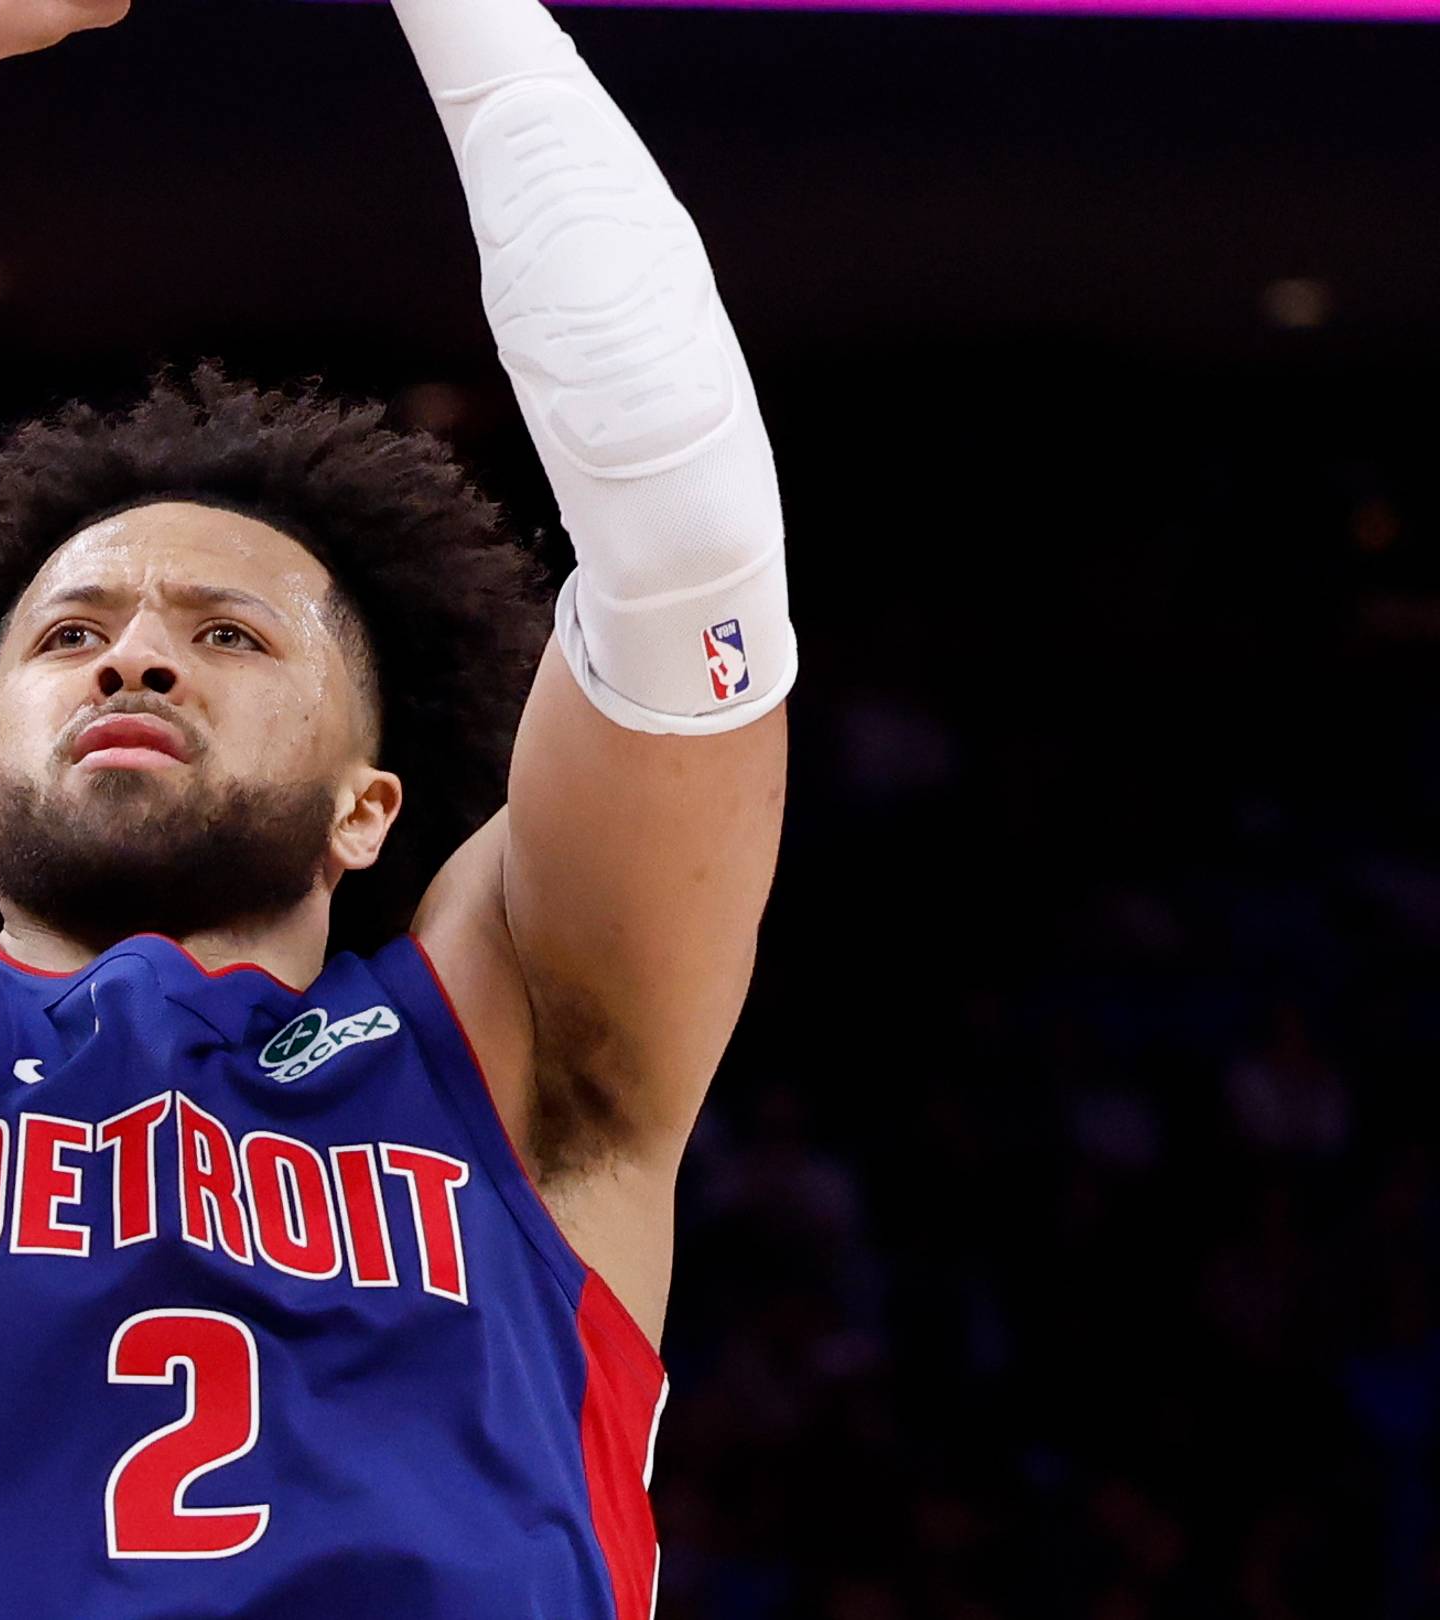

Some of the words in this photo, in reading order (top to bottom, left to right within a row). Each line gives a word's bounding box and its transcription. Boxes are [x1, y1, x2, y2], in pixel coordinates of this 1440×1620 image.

[715, 621, 737, 639] NBA
[276, 1010, 392, 1079] OCKX
[104, 1308, 270, 1559] 2
